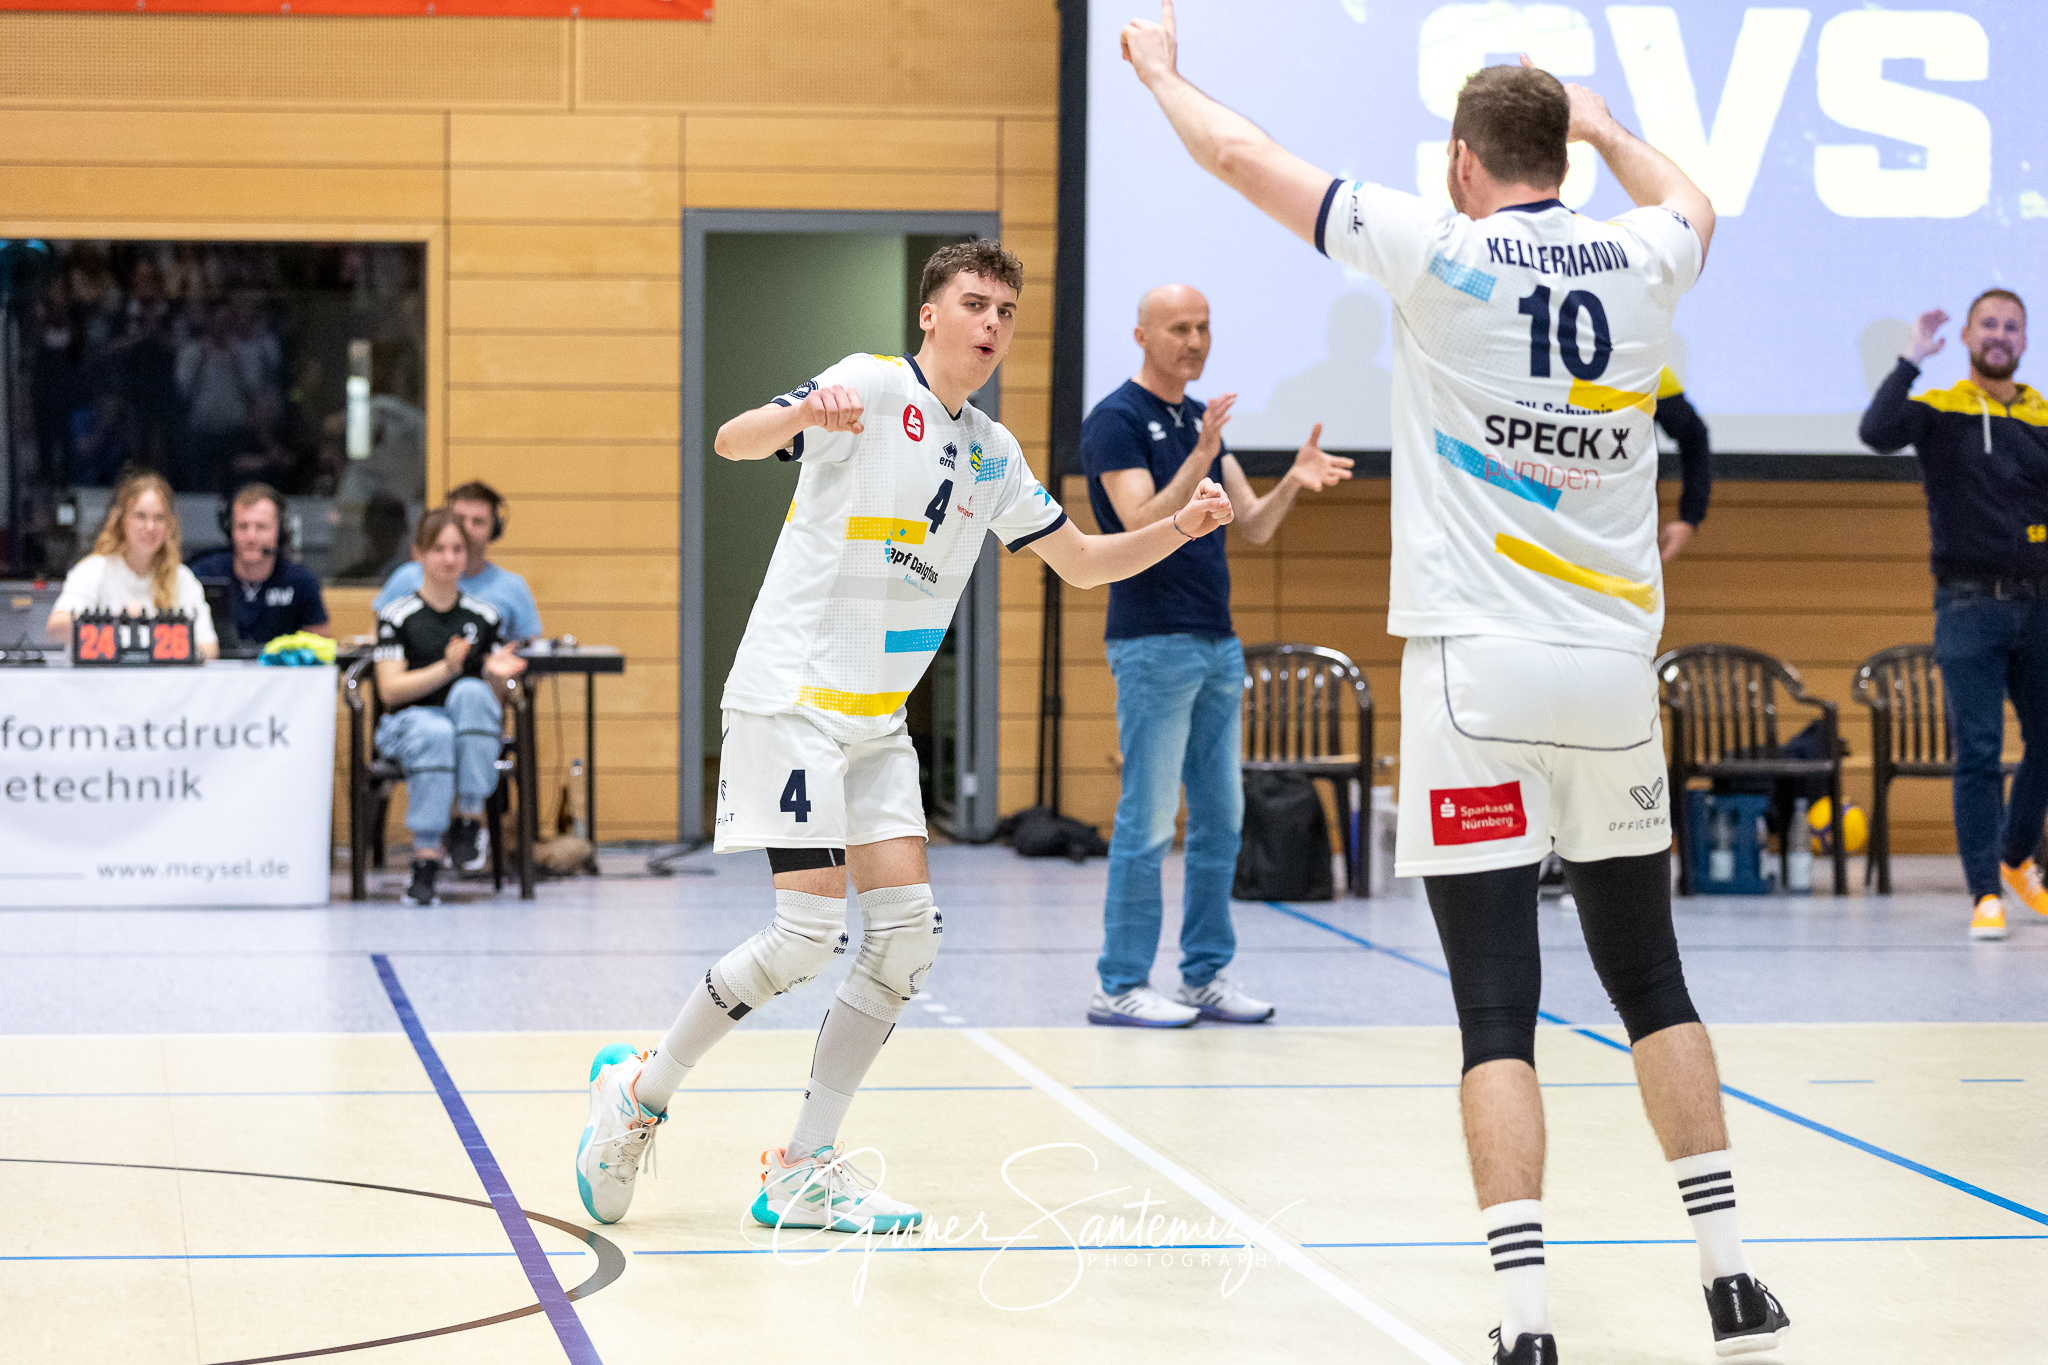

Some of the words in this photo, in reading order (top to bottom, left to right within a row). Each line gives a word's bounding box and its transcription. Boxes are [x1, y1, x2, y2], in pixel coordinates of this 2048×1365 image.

[1486, 237, 1629, 278] KELLERMANN
[1518, 284, 1613, 381] 10
[1485, 415, 1603, 460] SPECK
[1485, 454, 1602, 494] pumpen
[924, 478, 954, 535] 4
[80, 624, 117, 659] 24
[119, 625, 131, 648] 1
[138, 625, 150, 648] 1
[153, 624, 190, 660] 26
[0, 714, 290, 750] formatdruck
[5, 767, 203, 802] etechnik
[779, 769, 812, 823] 4
[1461, 803, 1515, 818] Sparkasse
[1461, 816, 1514, 831] Nürnberg
[97, 860, 290, 884] www.meysel.de
